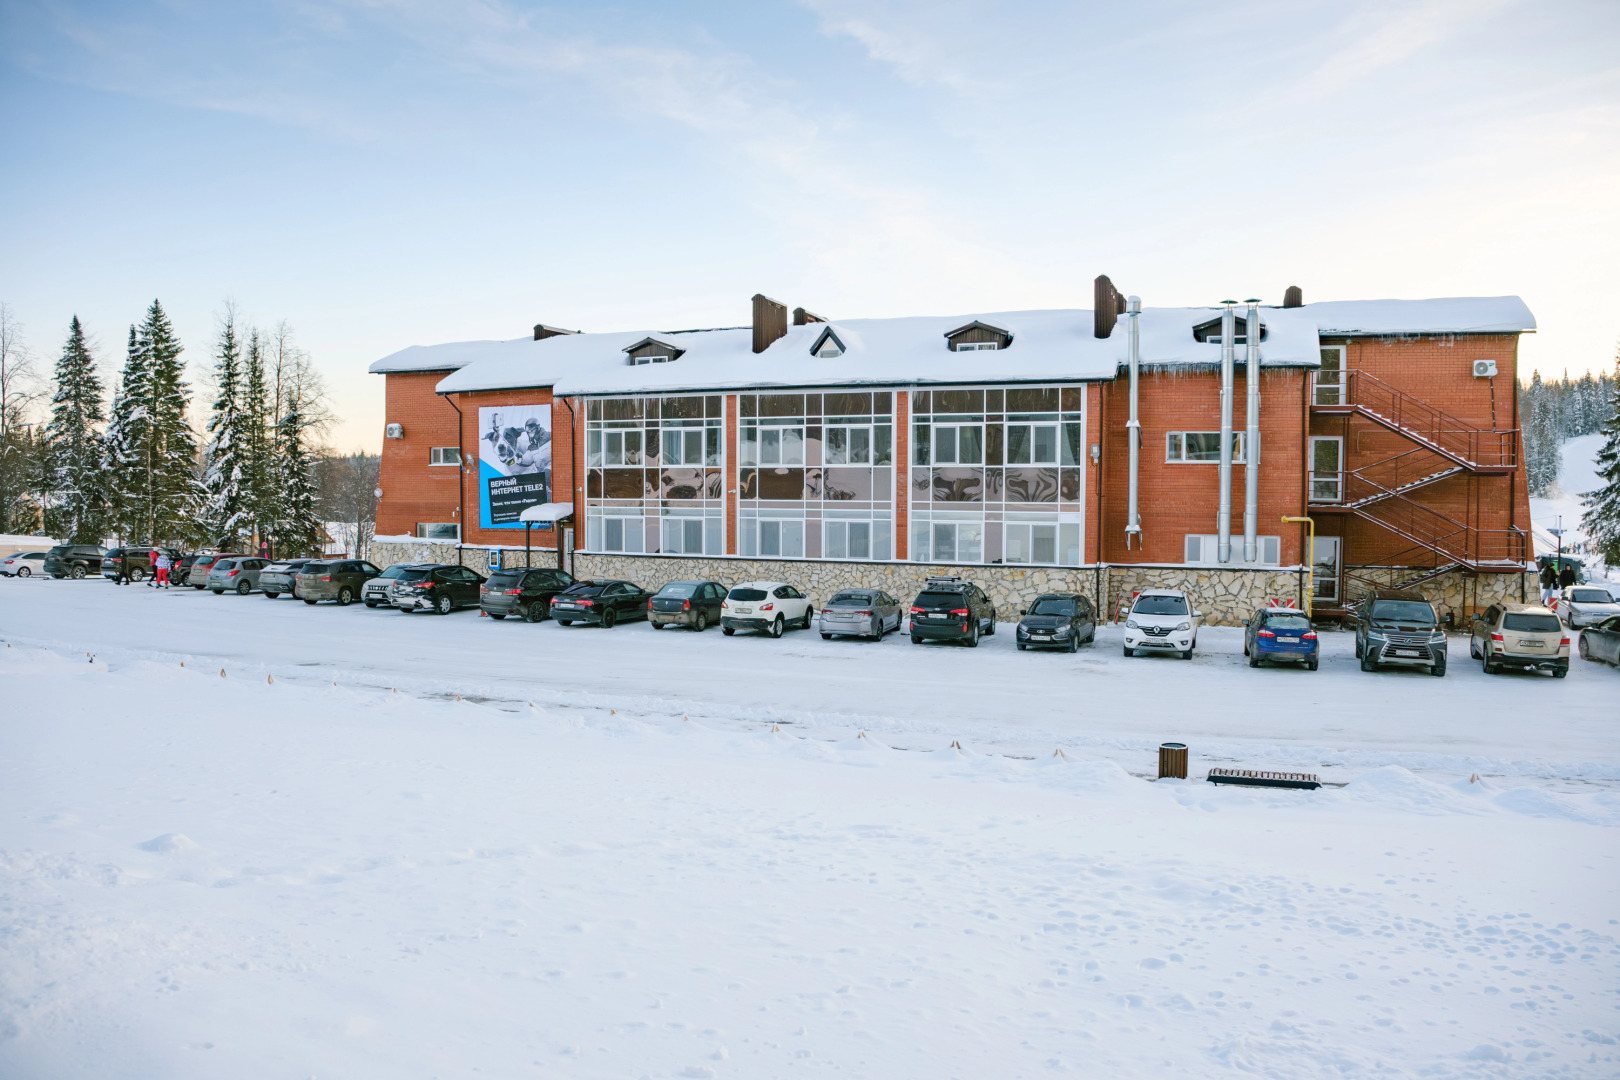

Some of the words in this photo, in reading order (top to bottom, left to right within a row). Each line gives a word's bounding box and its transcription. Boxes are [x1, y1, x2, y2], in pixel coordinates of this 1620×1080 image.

[490, 478, 516, 488] ВЕРНЫЙ
[491, 486, 523, 495] ИНТЕРНЕТ
[524, 484, 543, 492] TELE2
